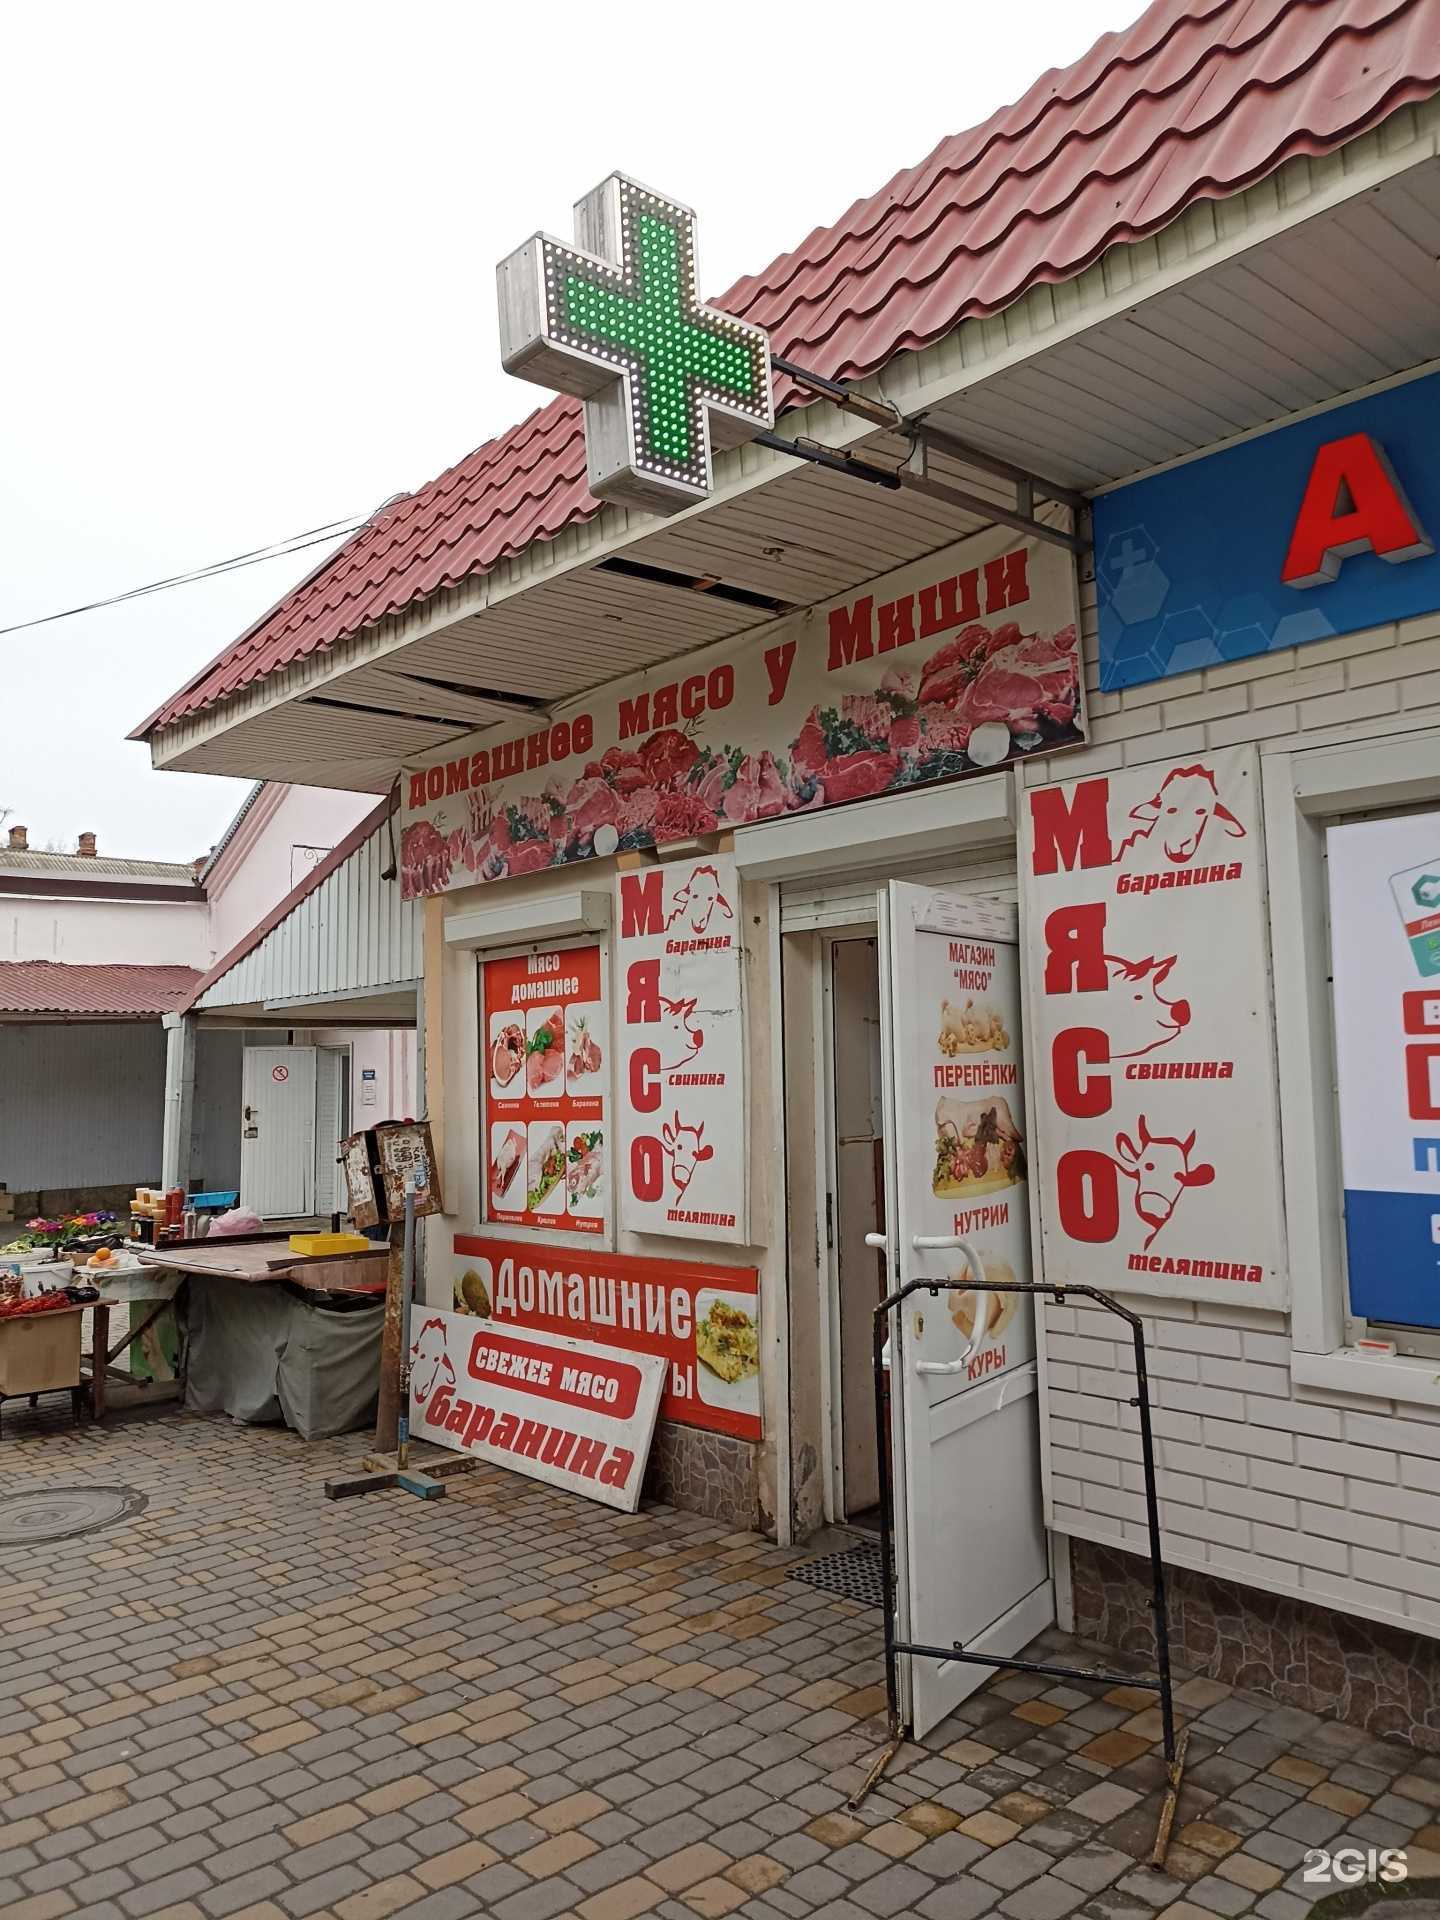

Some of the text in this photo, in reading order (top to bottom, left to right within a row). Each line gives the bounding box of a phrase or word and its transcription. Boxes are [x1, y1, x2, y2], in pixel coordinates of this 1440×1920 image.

[1281, 431, 1434, 589] А
[827, 548, 1031, 672] Миши
[1116, 861, 1242, 895] баранина
[665, 935, 732, 956] баранина
[948, 942, 996, 968] МАГАЗИН
[527, 954, 561, 975] Мясо
[511, 976, 579, 1005] домашнее
[1030, 777, 1120, 1244] МЯСО
[619, 870, 666, 1203] МЯСО
[667, 1071, 726, 1087] свинина
[933, 1060, 1018, 1088] ПЕРЕПЁЛКИ
[1125, 1058, 1234, 1080] свинина
[667, 1208, 736, 1227] телятина
[953, 1202, 1009, 1236] НУТРИИ
[1127, 1252, 1263, 1283] телятина
[496, 1258, 693, 1340] Домашние
[967, 1334, 1007, 1381] КУРЫ
[475, 1346, 620, 1404] СВЕЖЕЕ МЯСО
[424, 1384, 636, 1490] баранина
